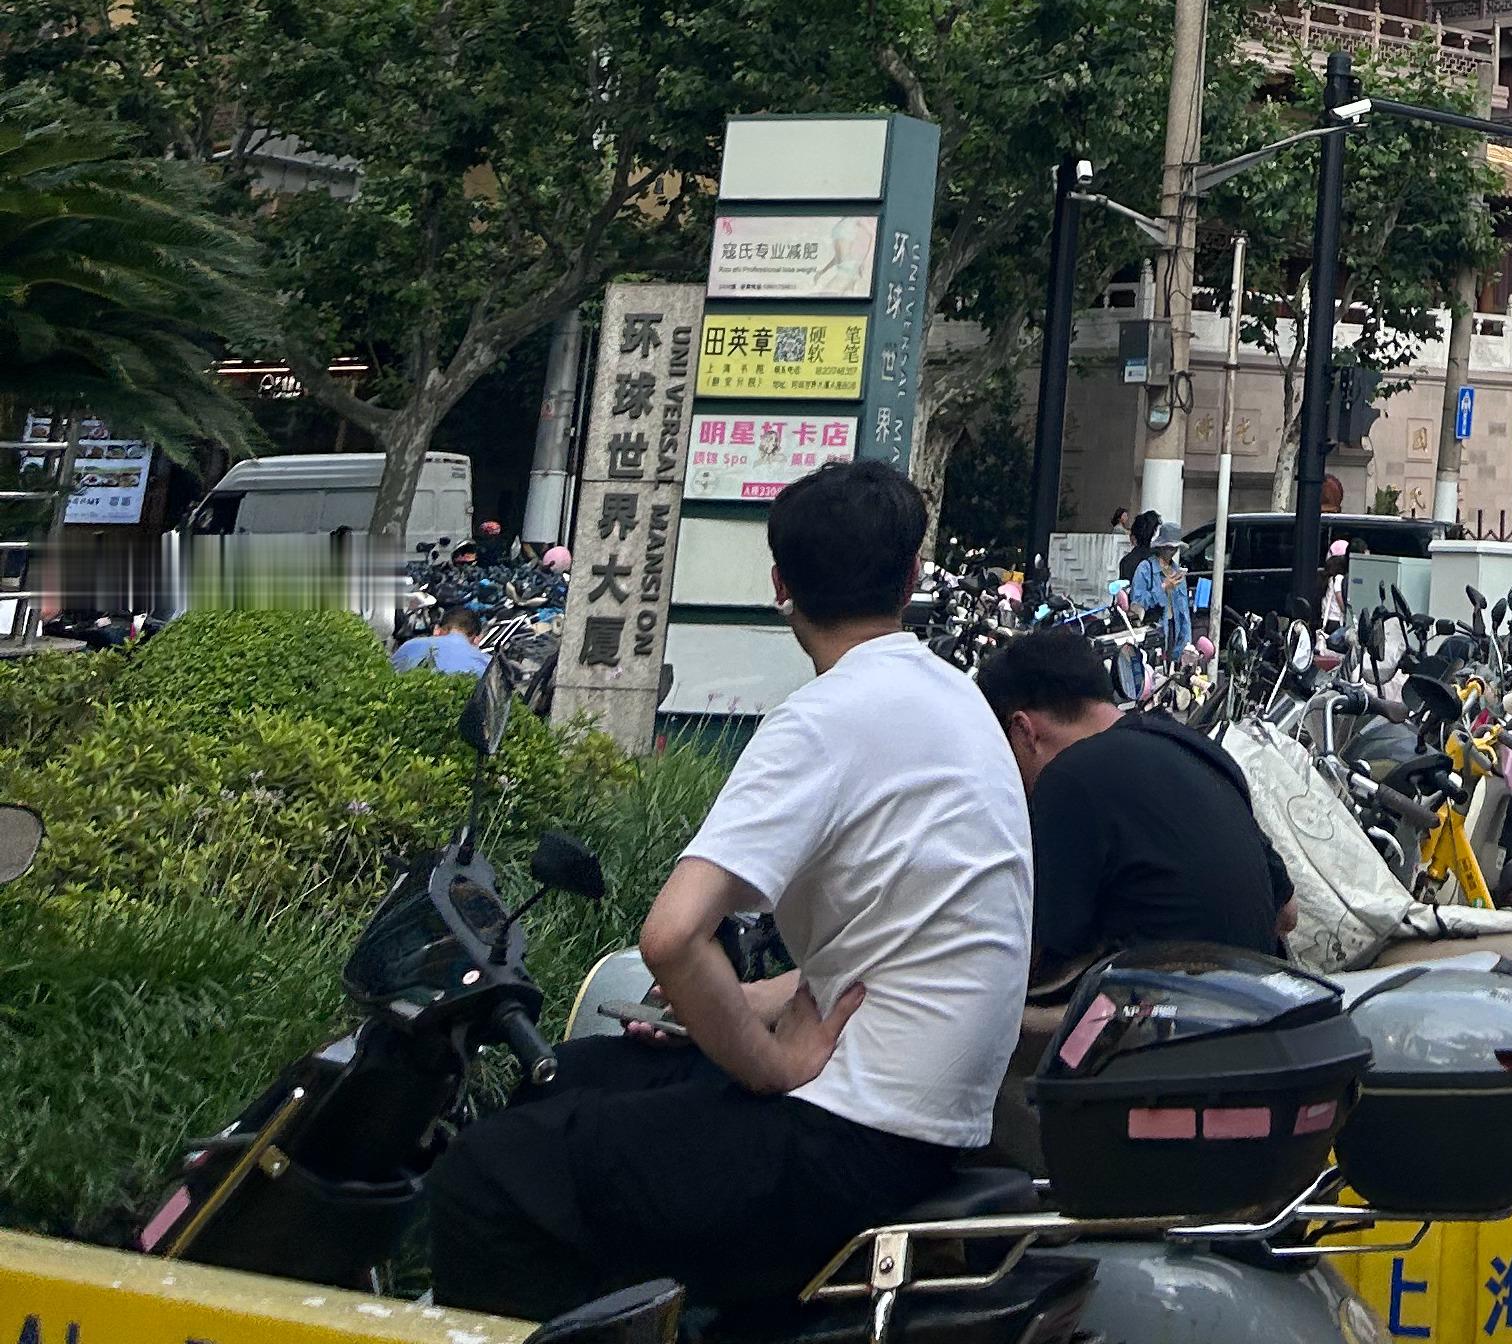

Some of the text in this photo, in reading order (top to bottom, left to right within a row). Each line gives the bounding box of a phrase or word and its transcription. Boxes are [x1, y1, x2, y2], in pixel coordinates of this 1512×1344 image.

[705, 326, 773, 356] 田英章
[700, 421, 849, 446] 明星打卡店
[578, 313, 664, 667] 环球世界大厦
